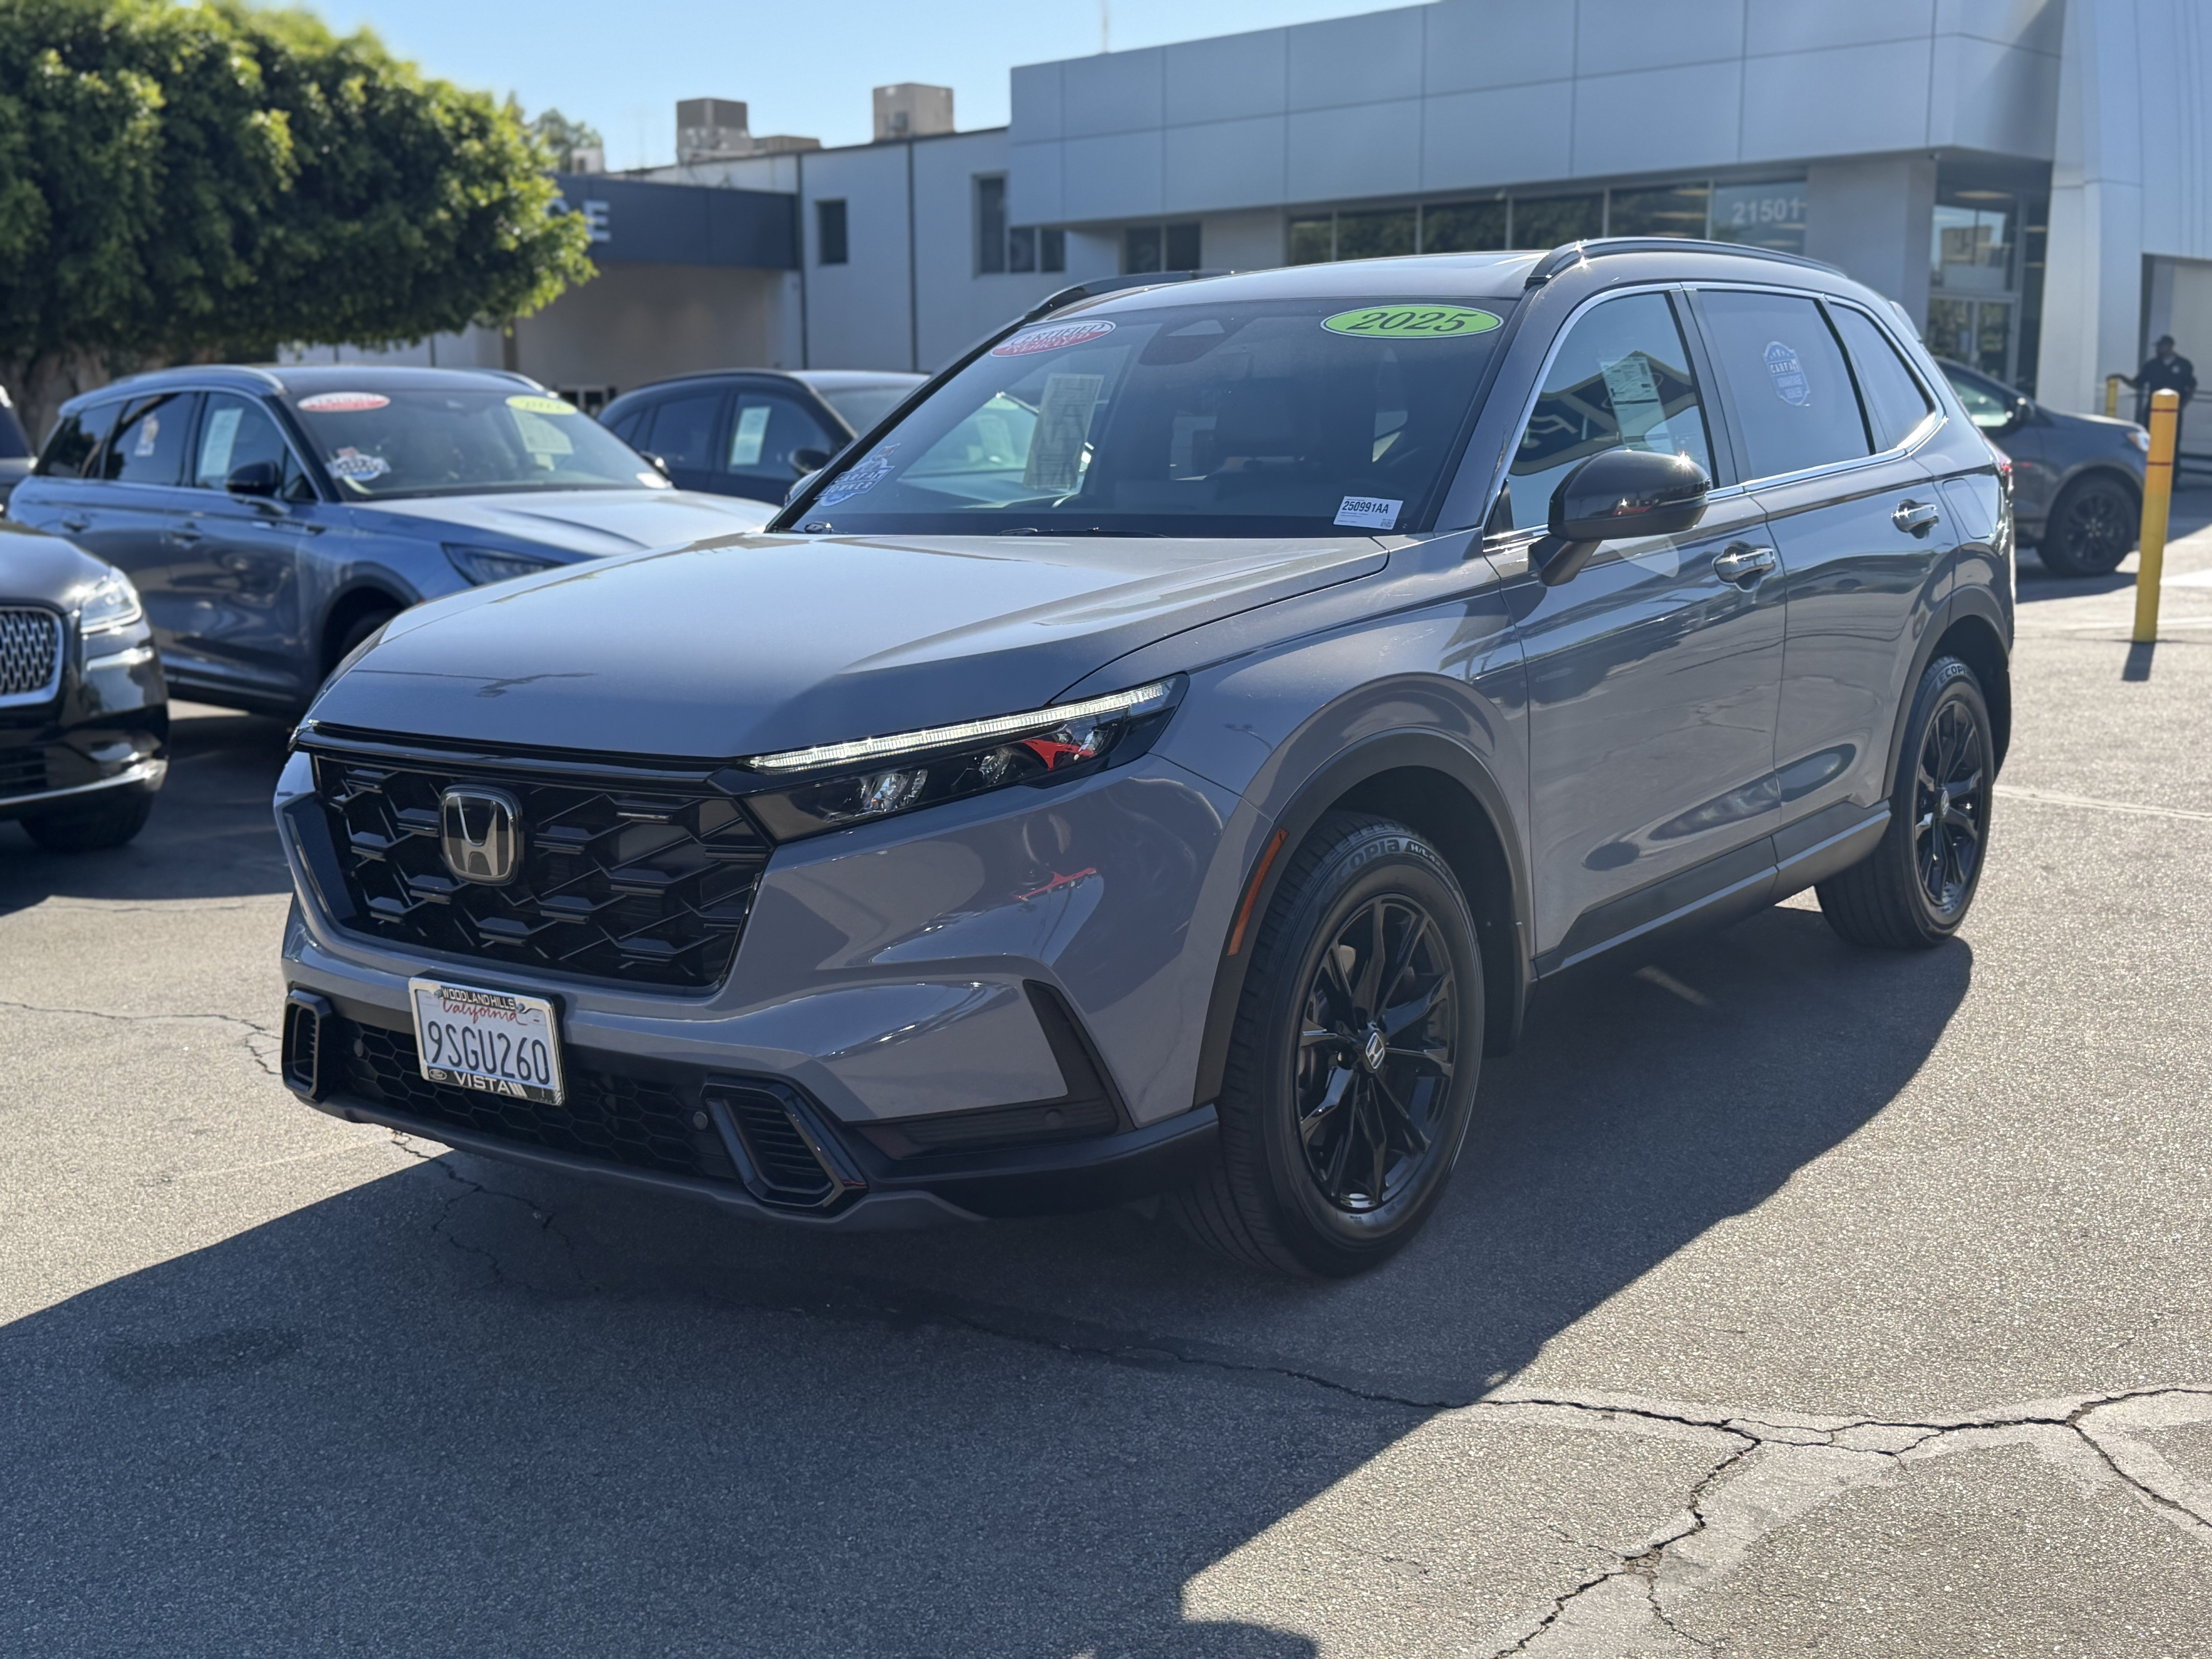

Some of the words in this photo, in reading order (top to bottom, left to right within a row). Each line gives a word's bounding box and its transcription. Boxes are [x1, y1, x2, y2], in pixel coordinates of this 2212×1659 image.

[1732, 198, 1800, 225] 21501
[1346, 311, 1478, 332] 2025
[1011, 324, 1105, 346] CERTIFIED
[1342, 501, 1389, 514] 250991AA
[441, 988, 490, 1005] WOODLAND
[489, 995, 515, 1010] HILLS
[443, 1000, 527, 1025] California
[428, 1020, 550, 1085] 9SGU260
[454, 1071, 510, 1096] VISTA
